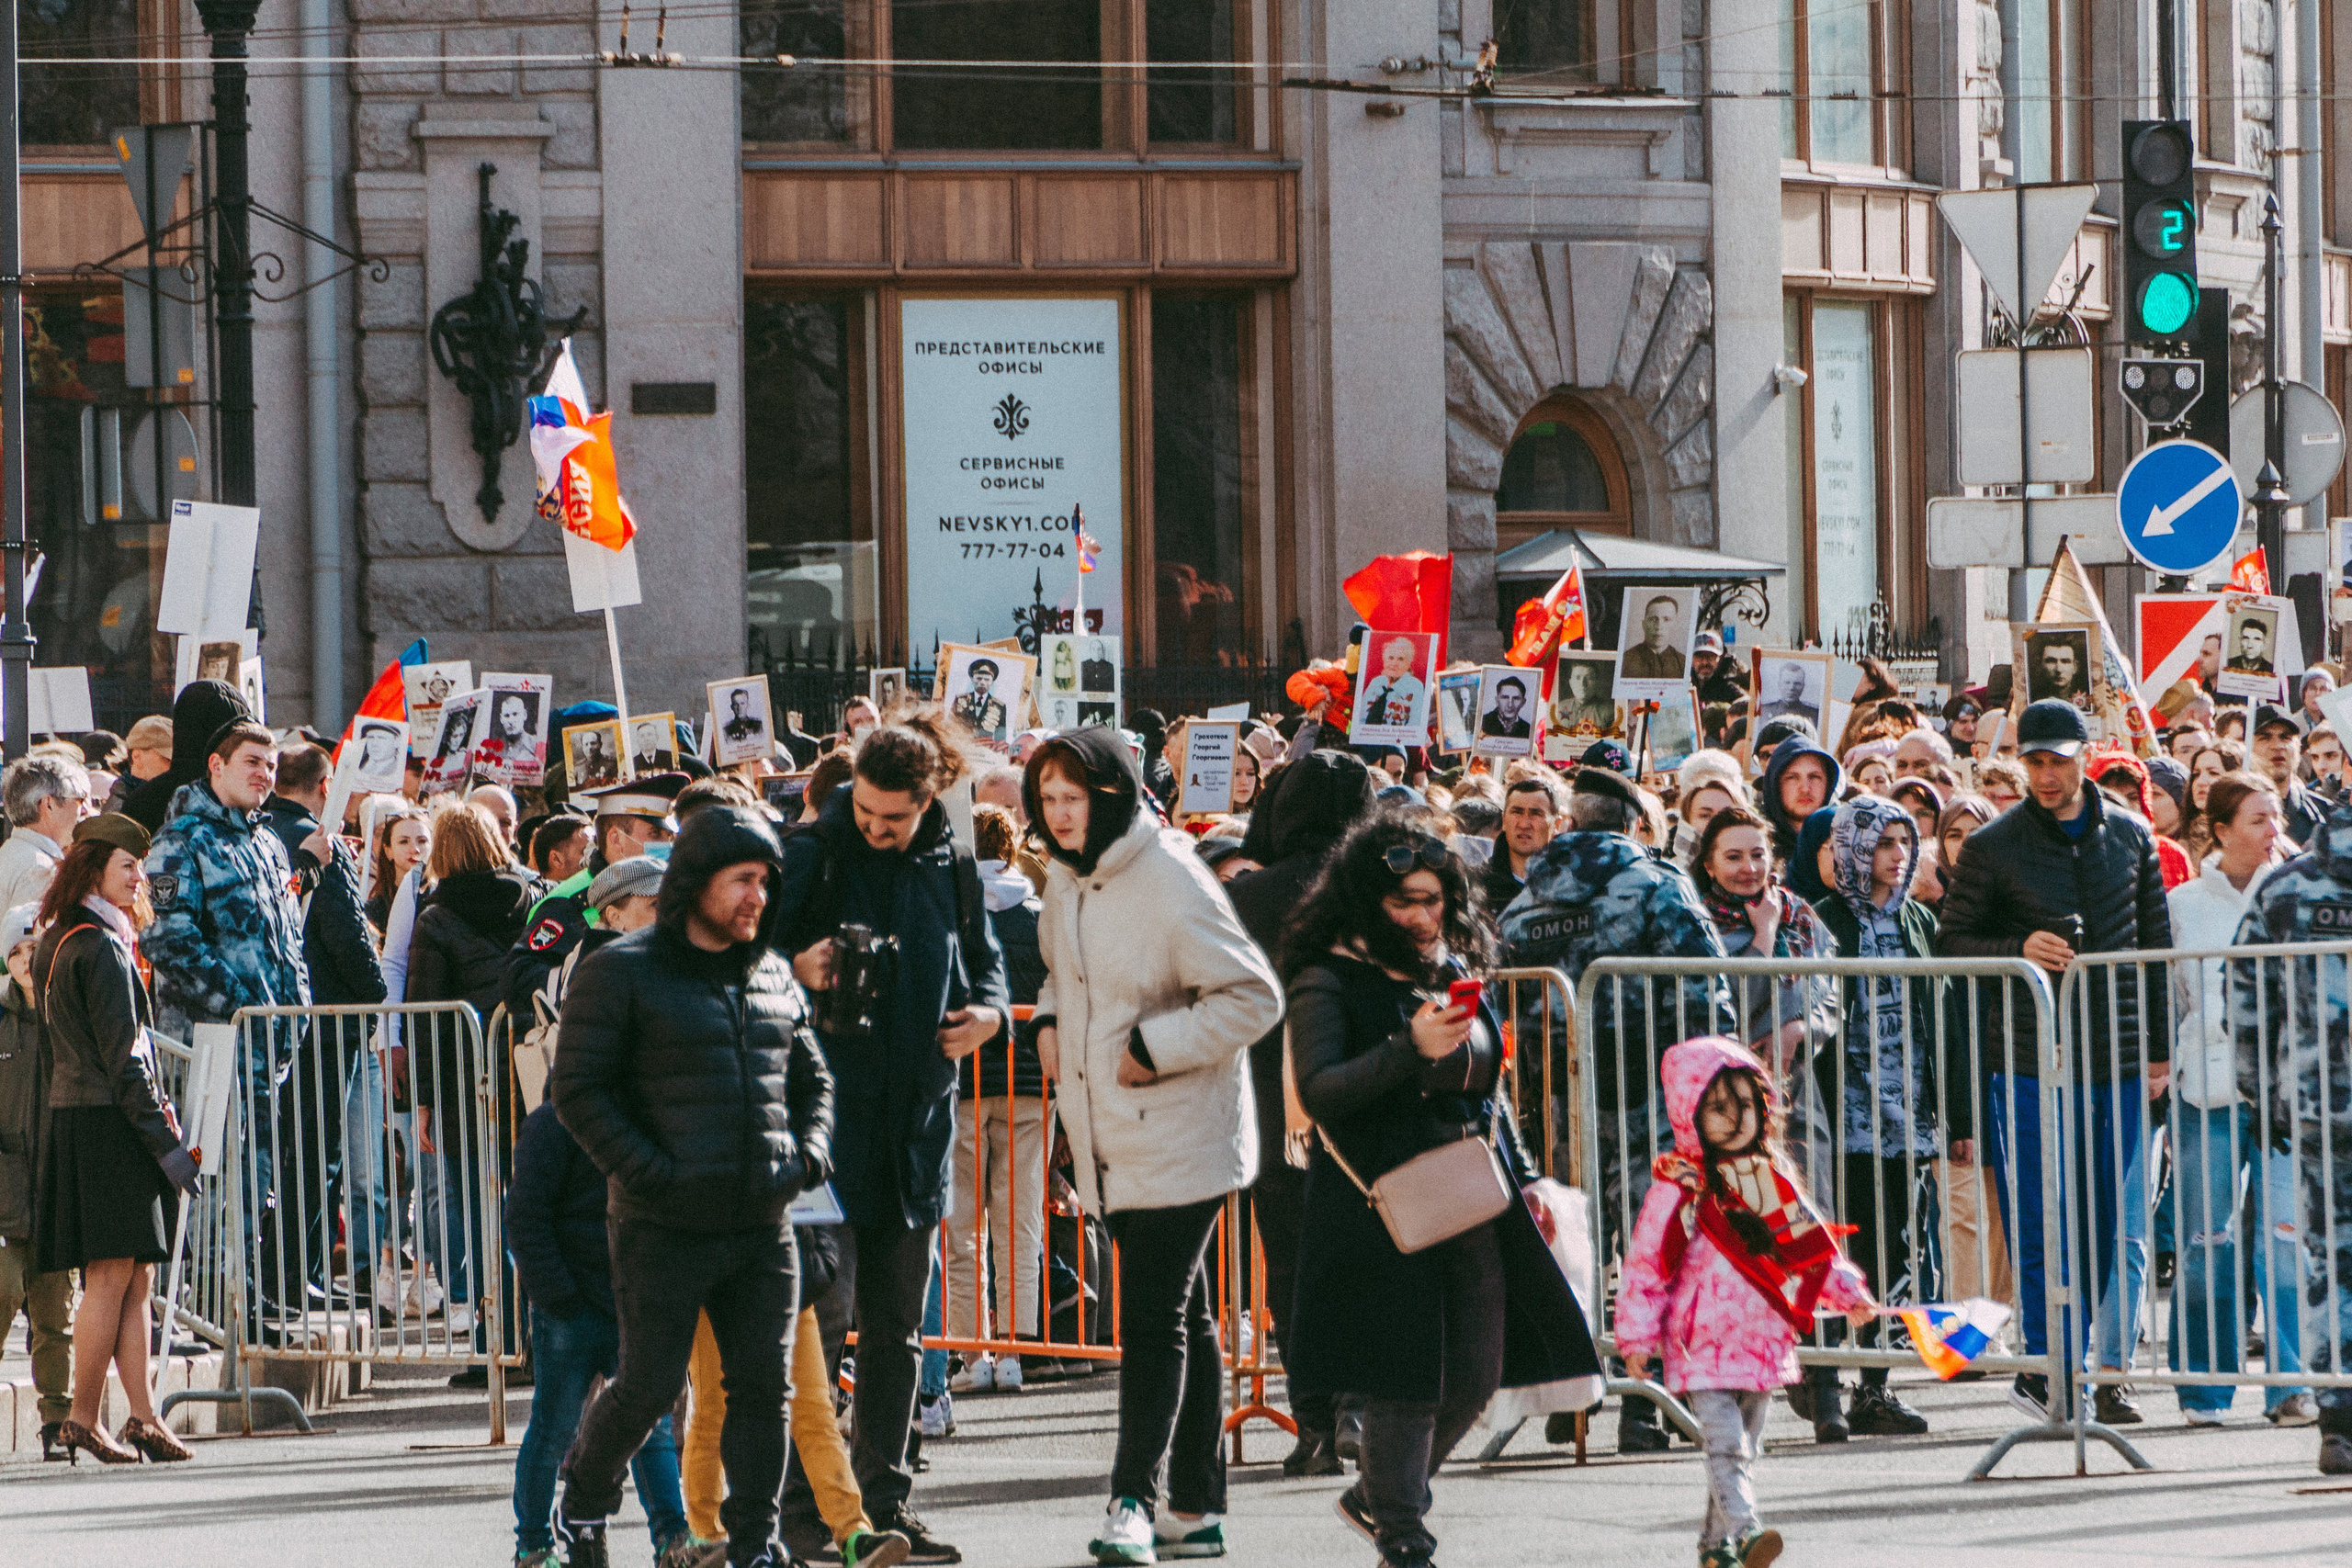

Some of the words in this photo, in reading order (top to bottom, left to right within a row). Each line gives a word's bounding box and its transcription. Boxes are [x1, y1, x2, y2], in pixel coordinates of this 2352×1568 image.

[2161, 209, 2183, 251] 2
[915, 341, 1105, 356] ПРЕДСТАВИТЕЛЬСКИЕ
[978, 361, 1043, 375] ОФИСЫ
[959, 457, 1064, 470] СЕРВИСНЫЕ
[980, 477, 1045, 490] ОФИСЫ
[939, 515, 1085, 532] NEVSKY1.CO
[960, 542, 1065, 558] 777-77-04
[1532, 915, 1589, 940] ОМОН
